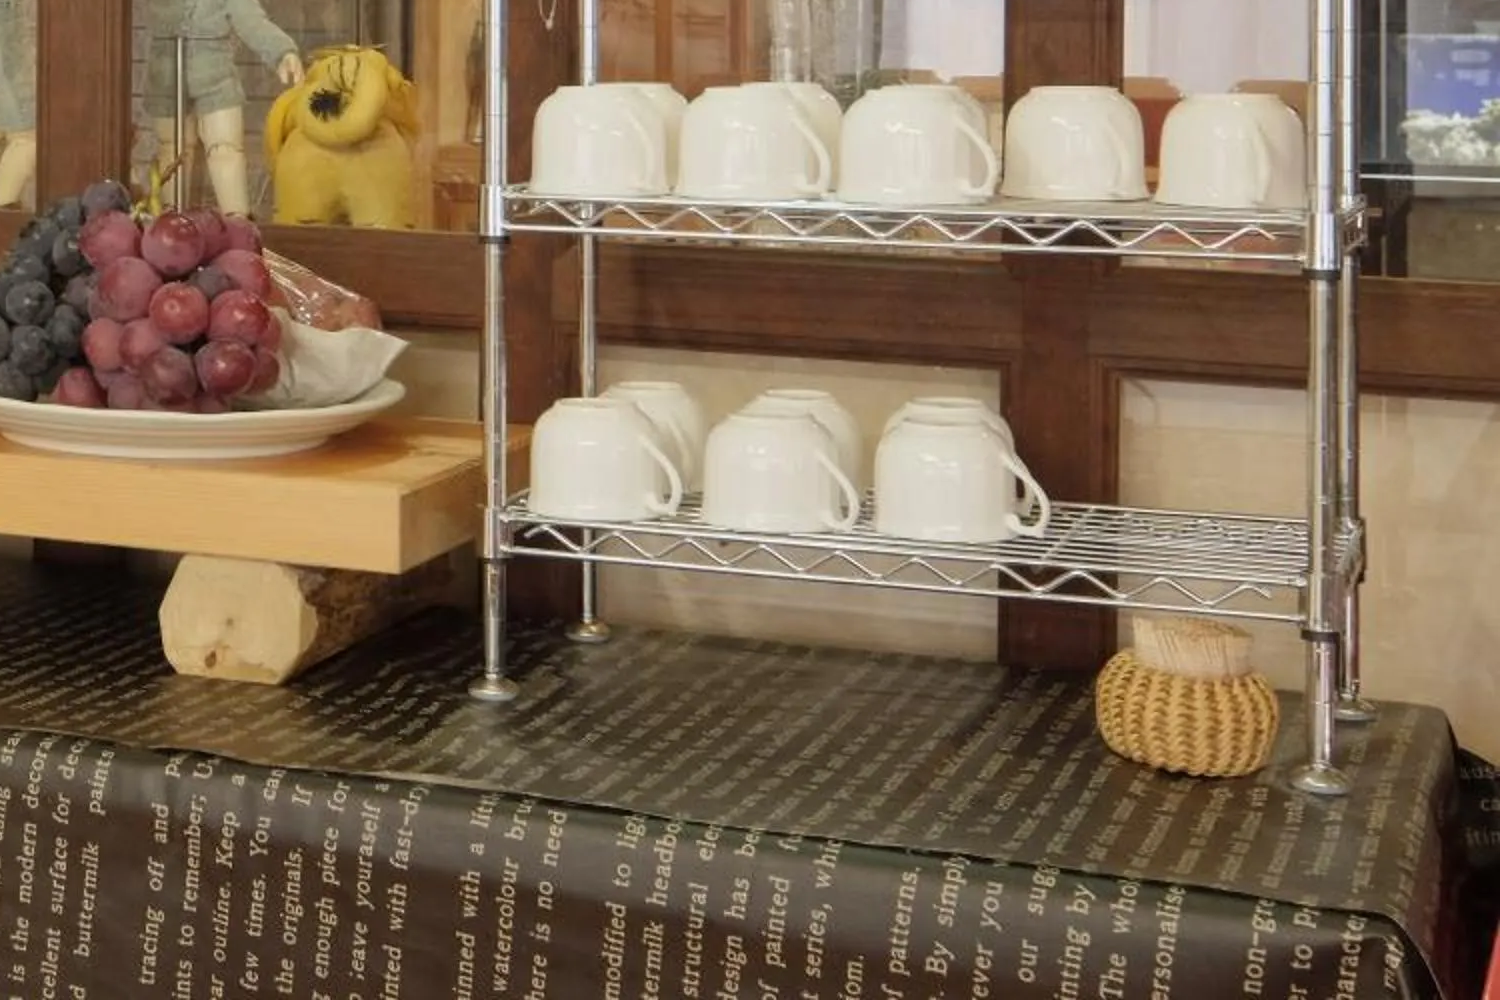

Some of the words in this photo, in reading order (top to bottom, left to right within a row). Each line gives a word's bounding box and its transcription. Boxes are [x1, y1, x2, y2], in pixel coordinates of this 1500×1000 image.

[51, 792, 70, 826] for
[150, 801, 168, 845] and
[248, 815, 271, 857] You
[15, 821, 37, 905] modern
[72, 841, 99, 958] buttermilk
[87, 750, 114, 817] paints
[214, 810, 240, 869] Keep
[316, 826, 340, 887] piece
[542, 809, 567, 868] need
[48, 836, 68, 916] surface
[146, 855, 165, 892] off
[273, 957, 294, 995] the
[290, 784, 313, 807] If
[536, 880, 553, 911] no
[723, 877, 750, 921] has
[1064, 883, 1096, 916] by
[492, 856, 519, 992] watercolour
[764, 874, 790, 969] painted
[979, 881, 1003, 932] you
[138, 905, 165, 986] tracing
[313, 896, 338, 980] enough
[681, 881, 708, 999] structural
[924, 940, 955, 977] By
[1017, 938, 1038, 984] our
[1290, 944, 1312, 971] to
[238, 950, 259, 992] few
